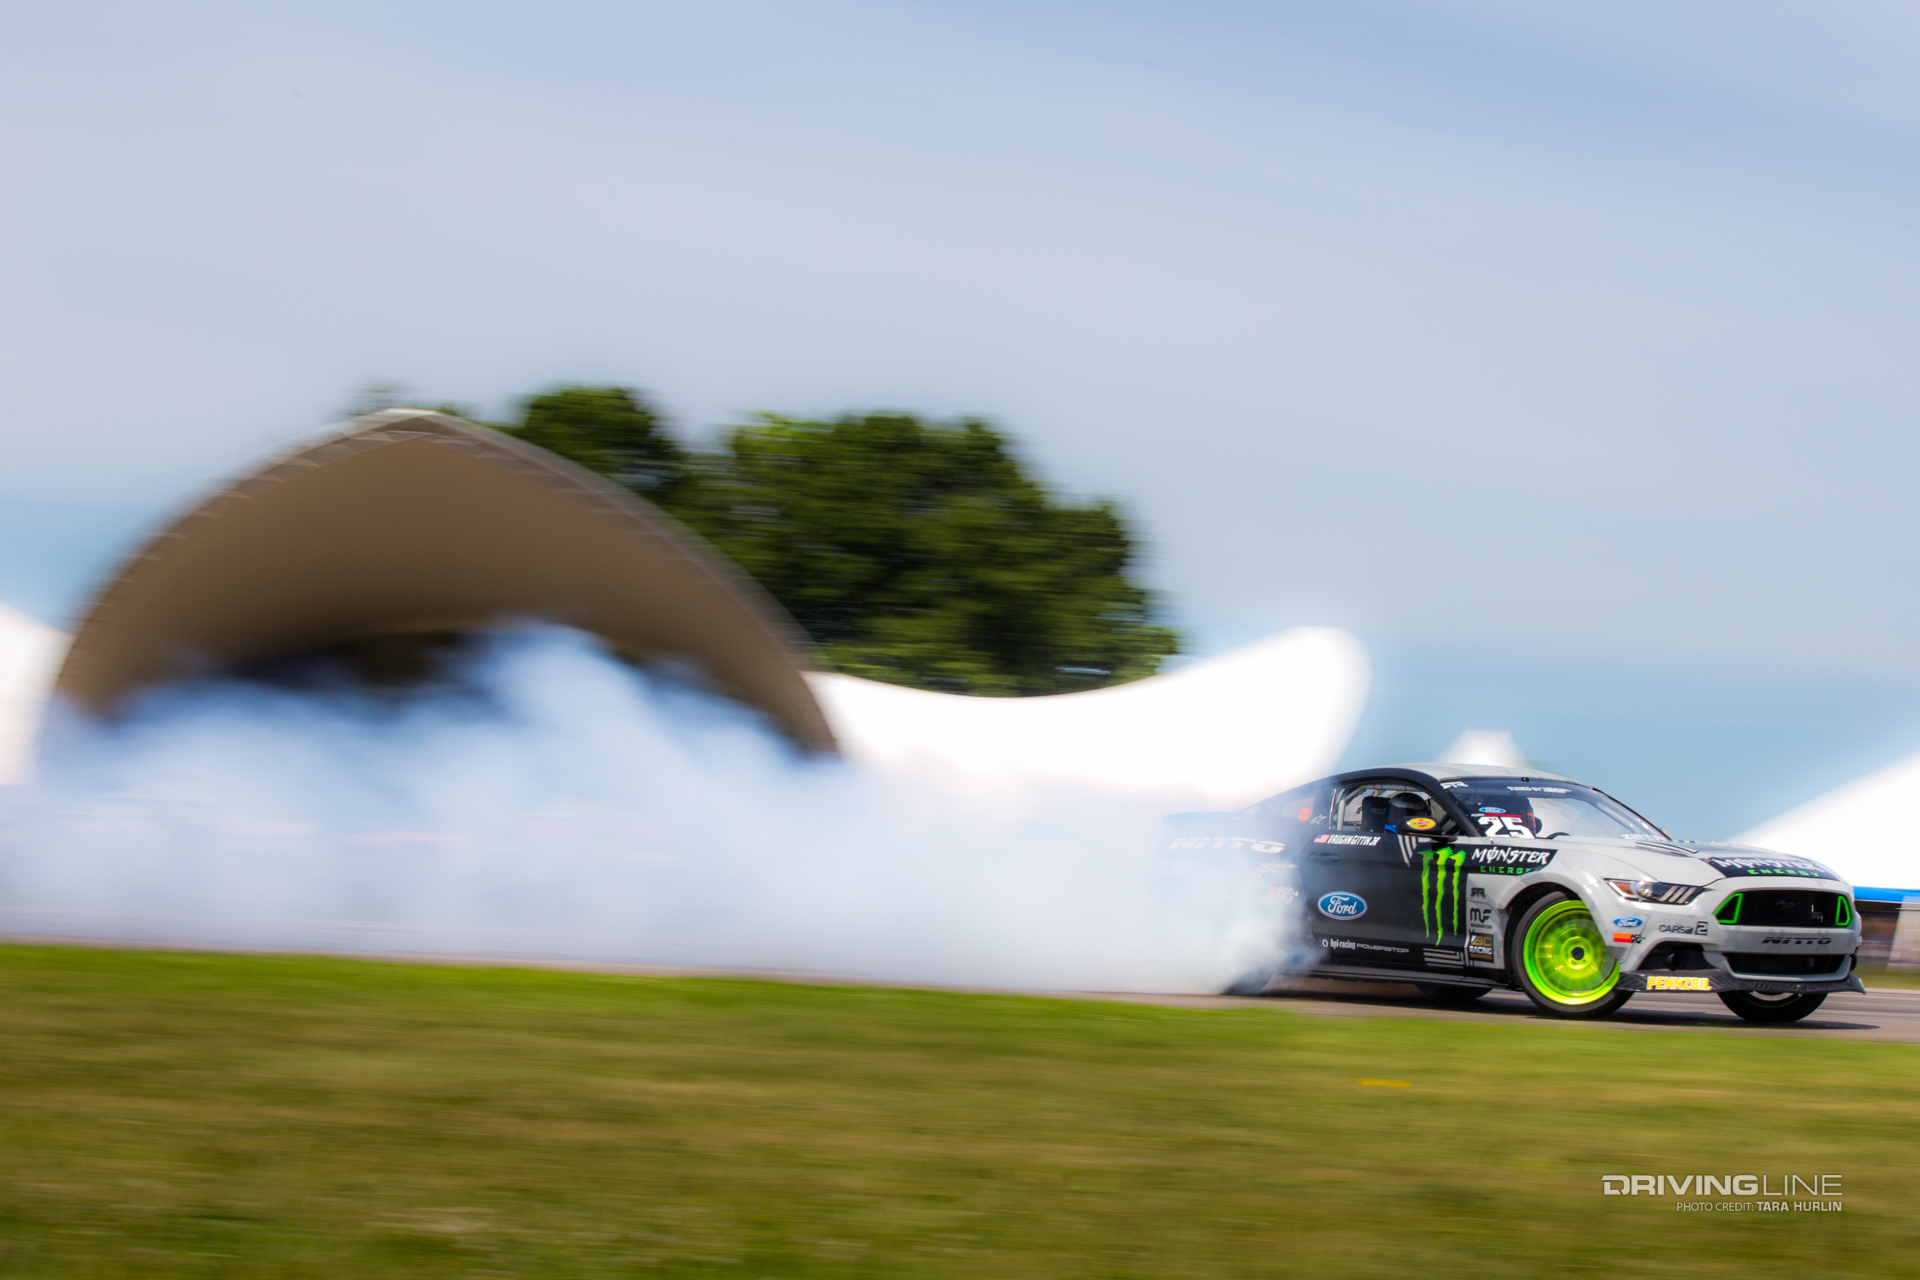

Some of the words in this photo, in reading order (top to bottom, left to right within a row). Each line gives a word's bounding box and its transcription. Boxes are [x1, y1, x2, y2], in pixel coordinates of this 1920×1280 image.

[1478, 816, 1535, 838] 25
[1167, 837, 1285, 854] NITTO
[1480, 866, 1532, 874] ENERGY
[1748, 868, 1819, 877] ENERGY
[1327, 896, 1358, 915] Ford
[1658, 924, 1685, 934] CARS
[1330, 938, 1356, 950] hpi-racing
[1762, 936, 1832, 945] NITTO
[1469, 946, 1492, 955] RACING
[1646, 976, 1712, 990] PENNZOIL
